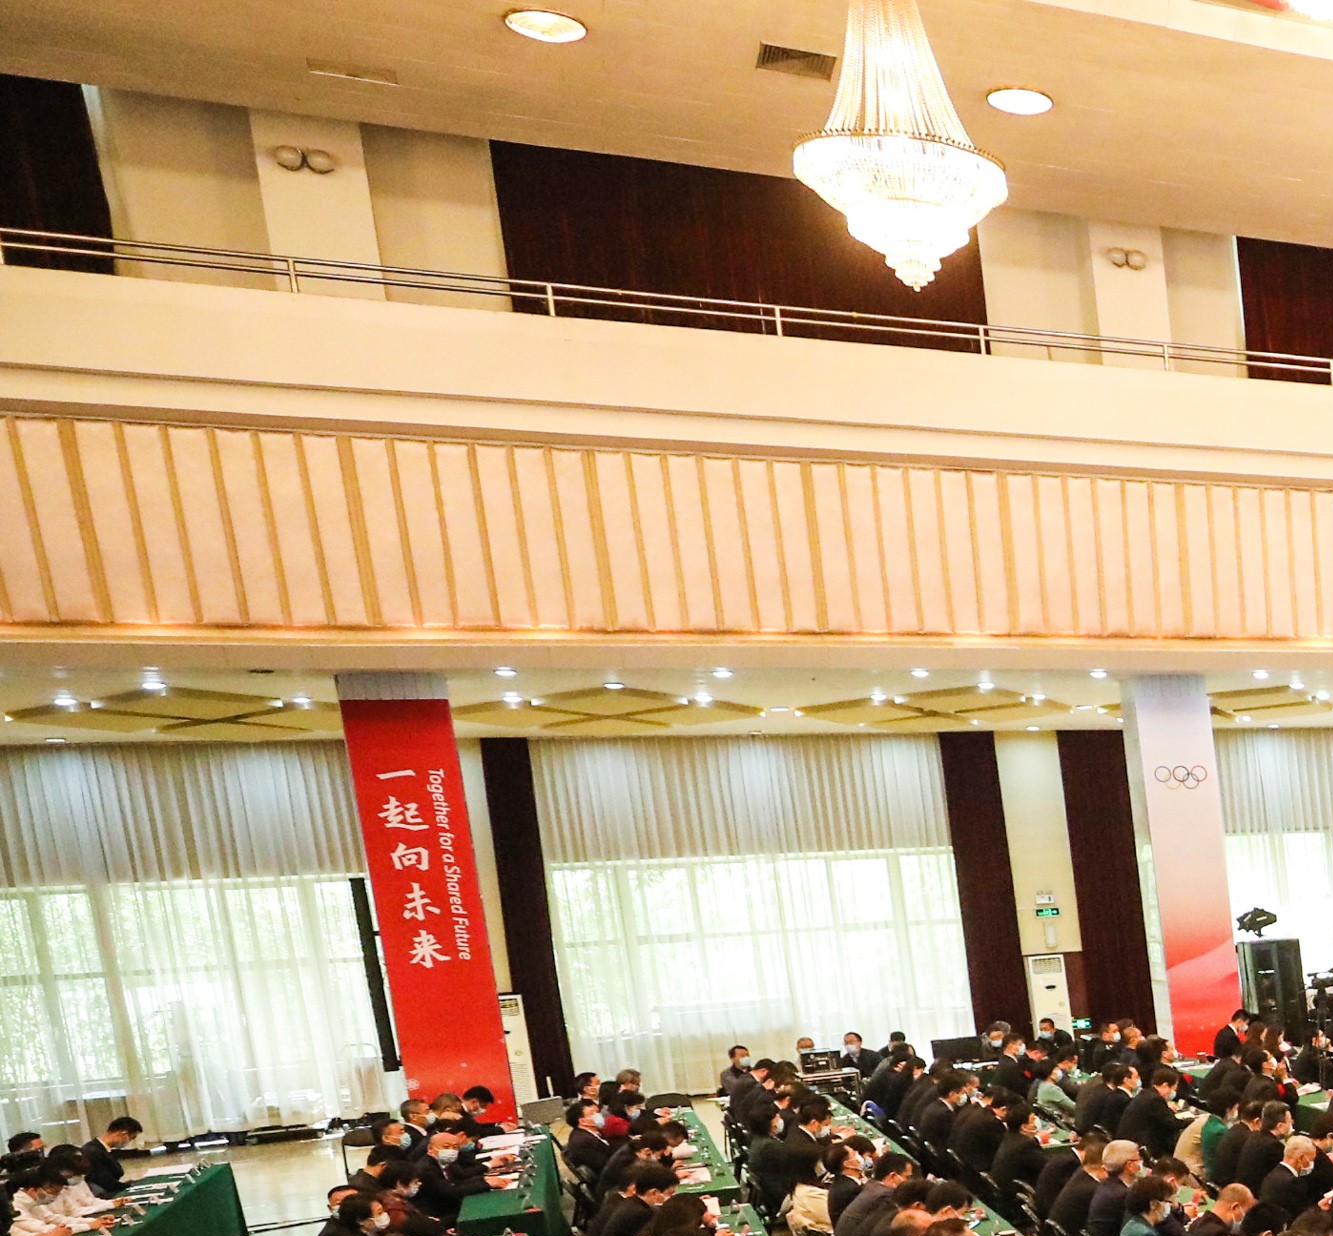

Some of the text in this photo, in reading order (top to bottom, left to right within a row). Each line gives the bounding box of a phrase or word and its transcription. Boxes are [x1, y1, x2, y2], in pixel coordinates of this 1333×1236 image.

[376, 769, 451, 969] 一起向未来
[427, 768, 471, 961] Together for a Shared Future
